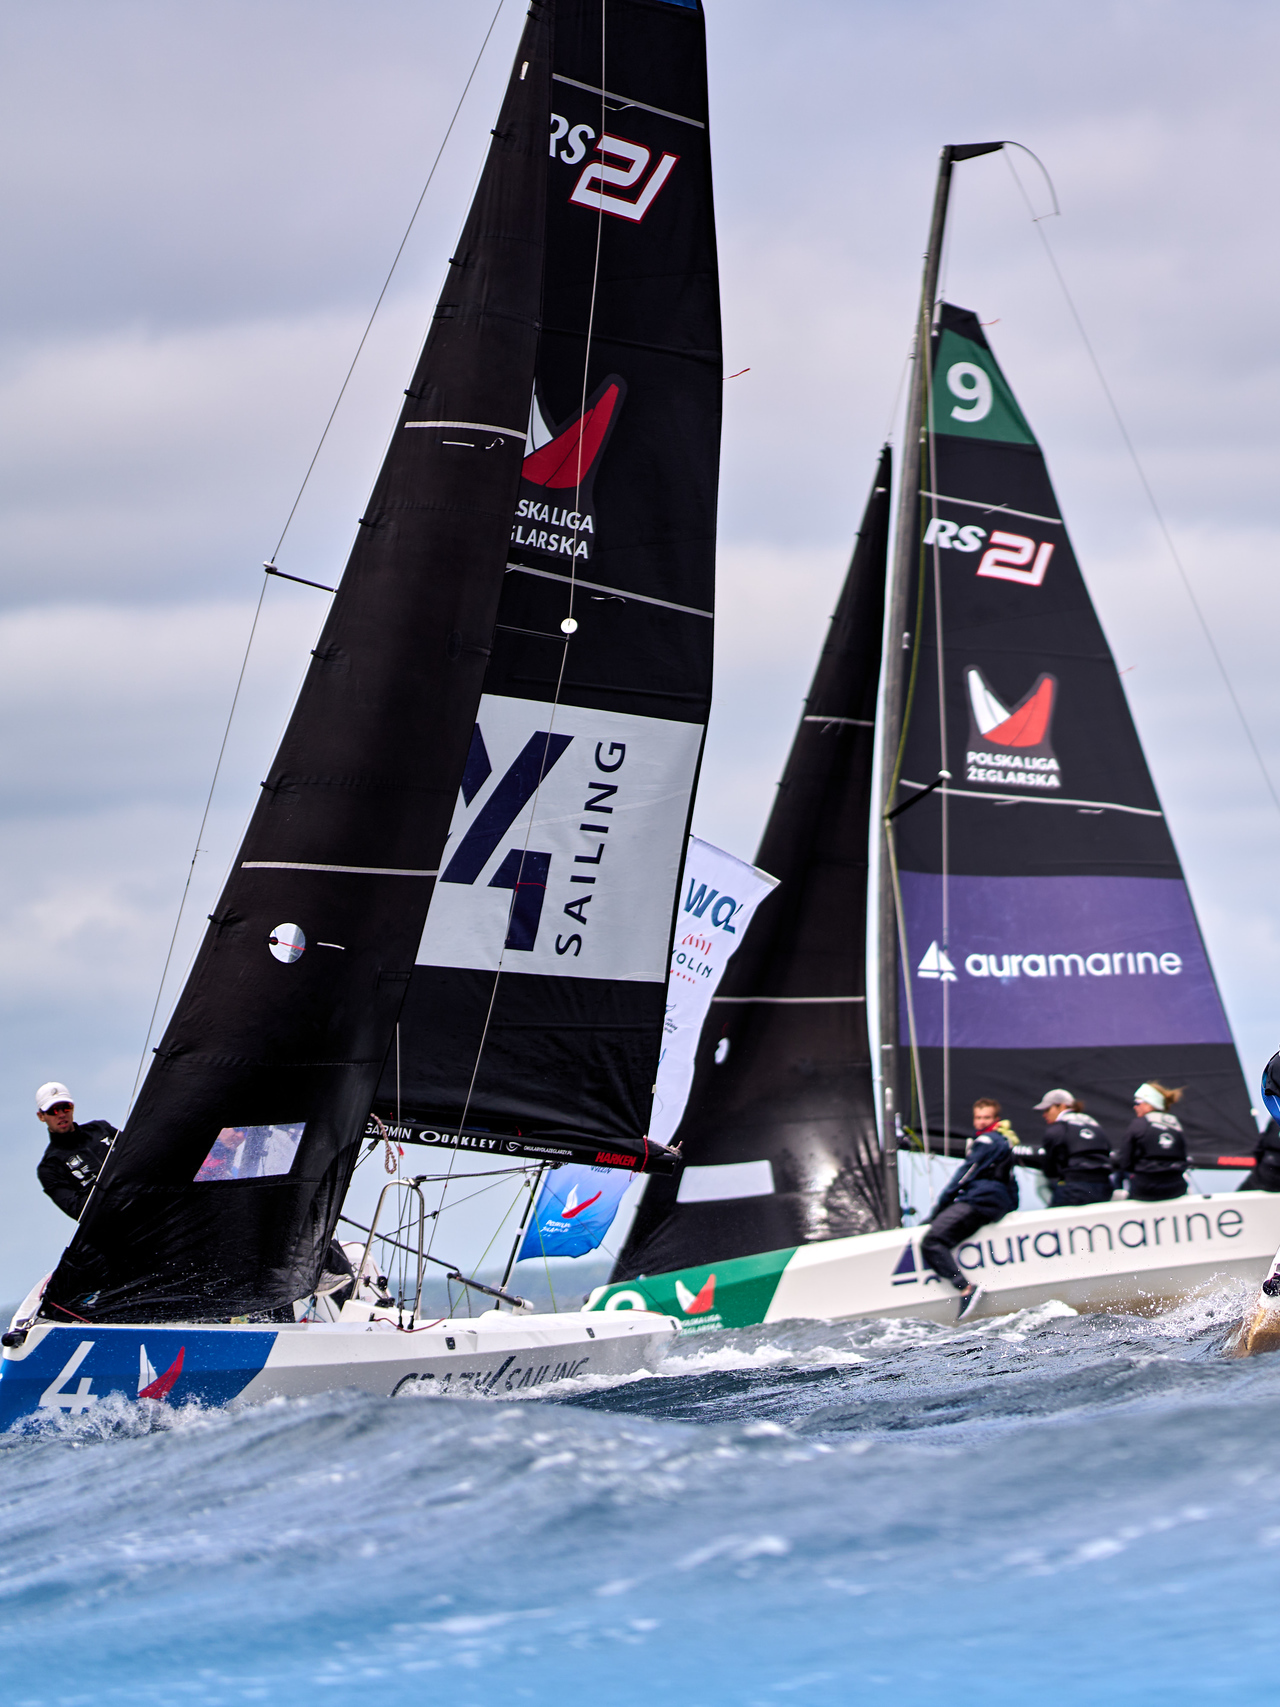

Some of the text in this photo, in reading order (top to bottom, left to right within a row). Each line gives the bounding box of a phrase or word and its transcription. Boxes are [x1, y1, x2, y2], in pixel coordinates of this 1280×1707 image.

[549, 113, 682, 225] RS 21
[946, 361, 994, 423] 9
[515, 499, 594, 534] SKA LIGA
[922, 517, 1055, 587] RS 21
[966, 751, 1060, 771] POLSKA LIGA
[966, 765, 1062, 789] ŻEGLARSKA
[555, 741, 627, 957] SAILING
[672, 949, 713, 979] OLIN
[965, 952, 1183, 977] auramarine
[441, 1134, 496, 1149] OAKLEY
[595, 1152, 638, 1167] HARKEN
[956, 1209, 1245, 1270] auramarine
[39, 1341, 98, 1414] 4
